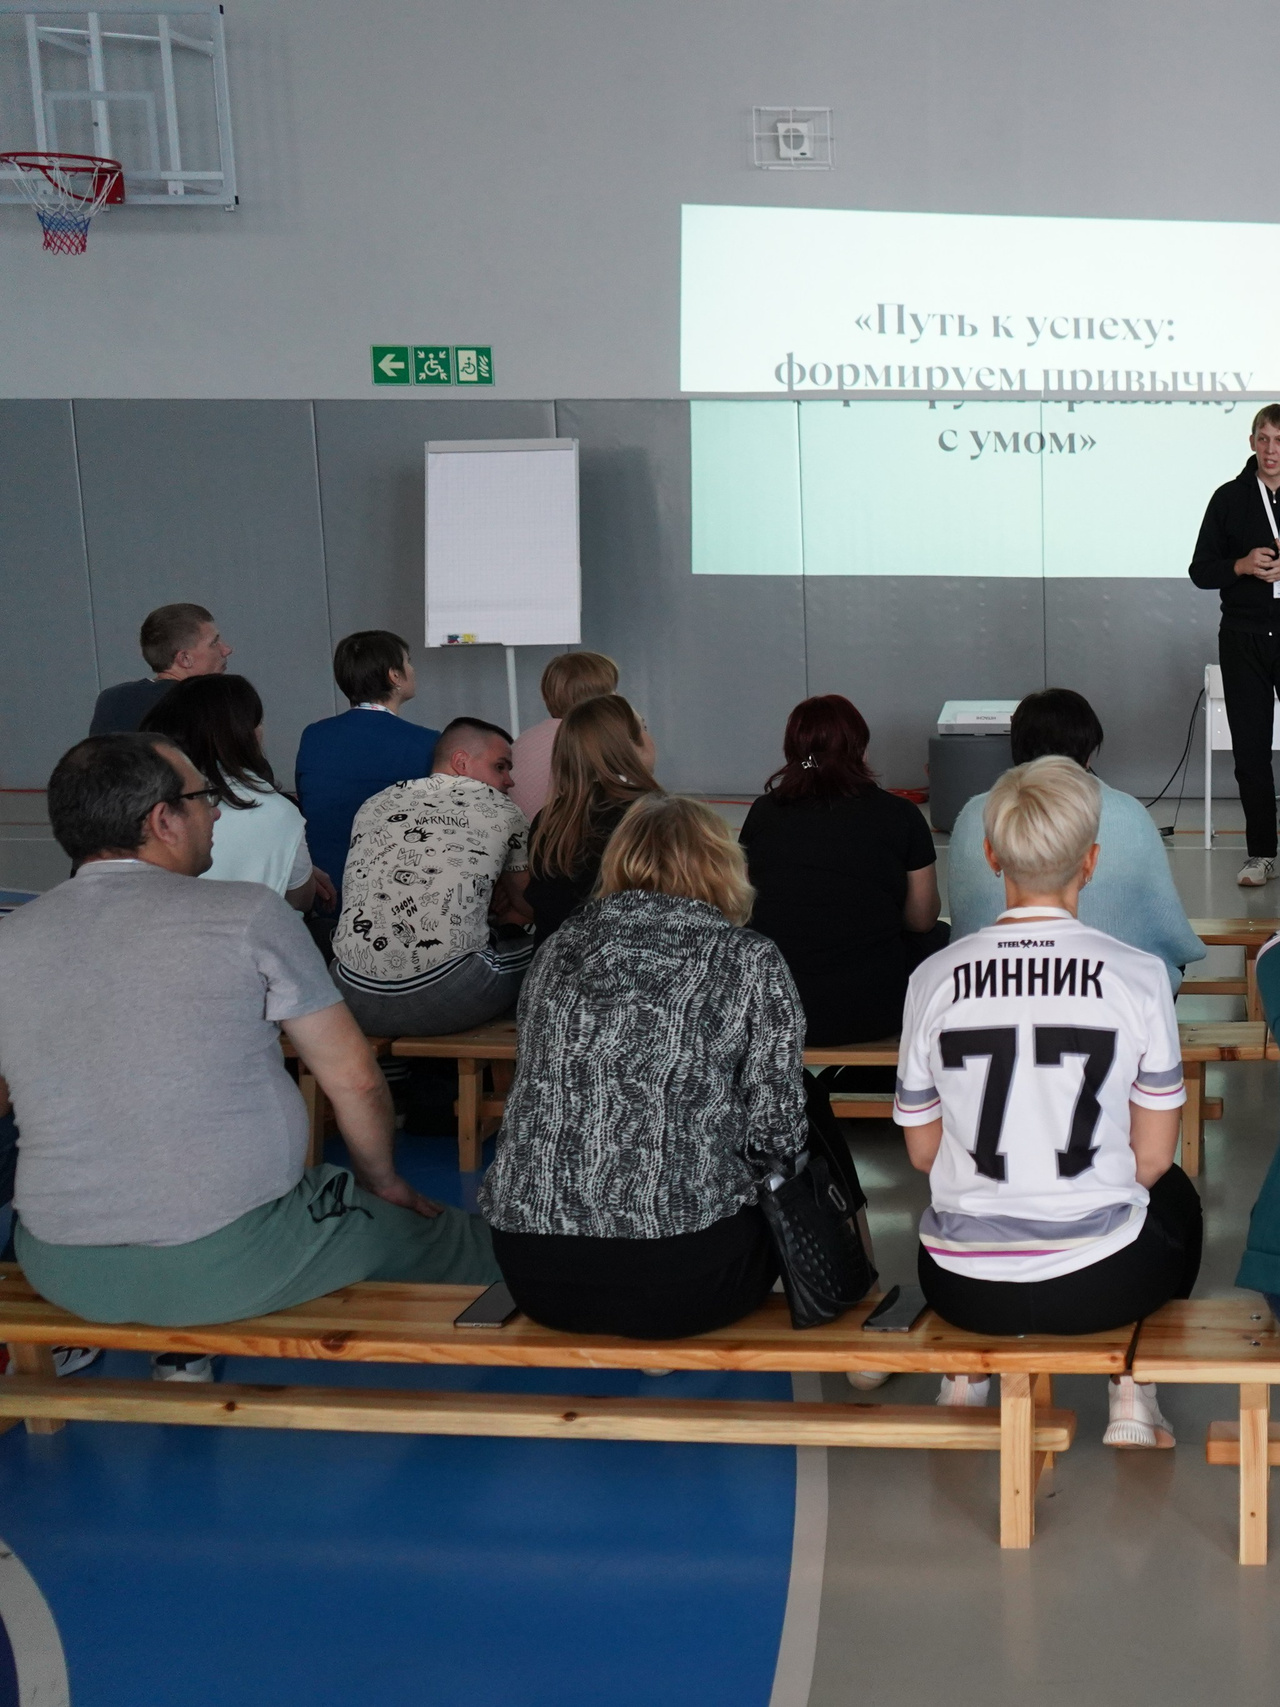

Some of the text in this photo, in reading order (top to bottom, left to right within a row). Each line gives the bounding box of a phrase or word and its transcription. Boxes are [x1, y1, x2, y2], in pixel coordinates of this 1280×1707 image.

[854, 303, 1175, 348] «Путь к успеху:
[774, 352, 1254, 413] формируем привычку
[938, 428, 1097, 460] с умом»
[414, 814, 470, 828] WARNING!
[391, 895, 414, 916] HOPES
[406, 904, 418, 918] NO
[952, 957, 1105, 1004] ЛИННИК
[938, 1023, 1120, 1184] 77
